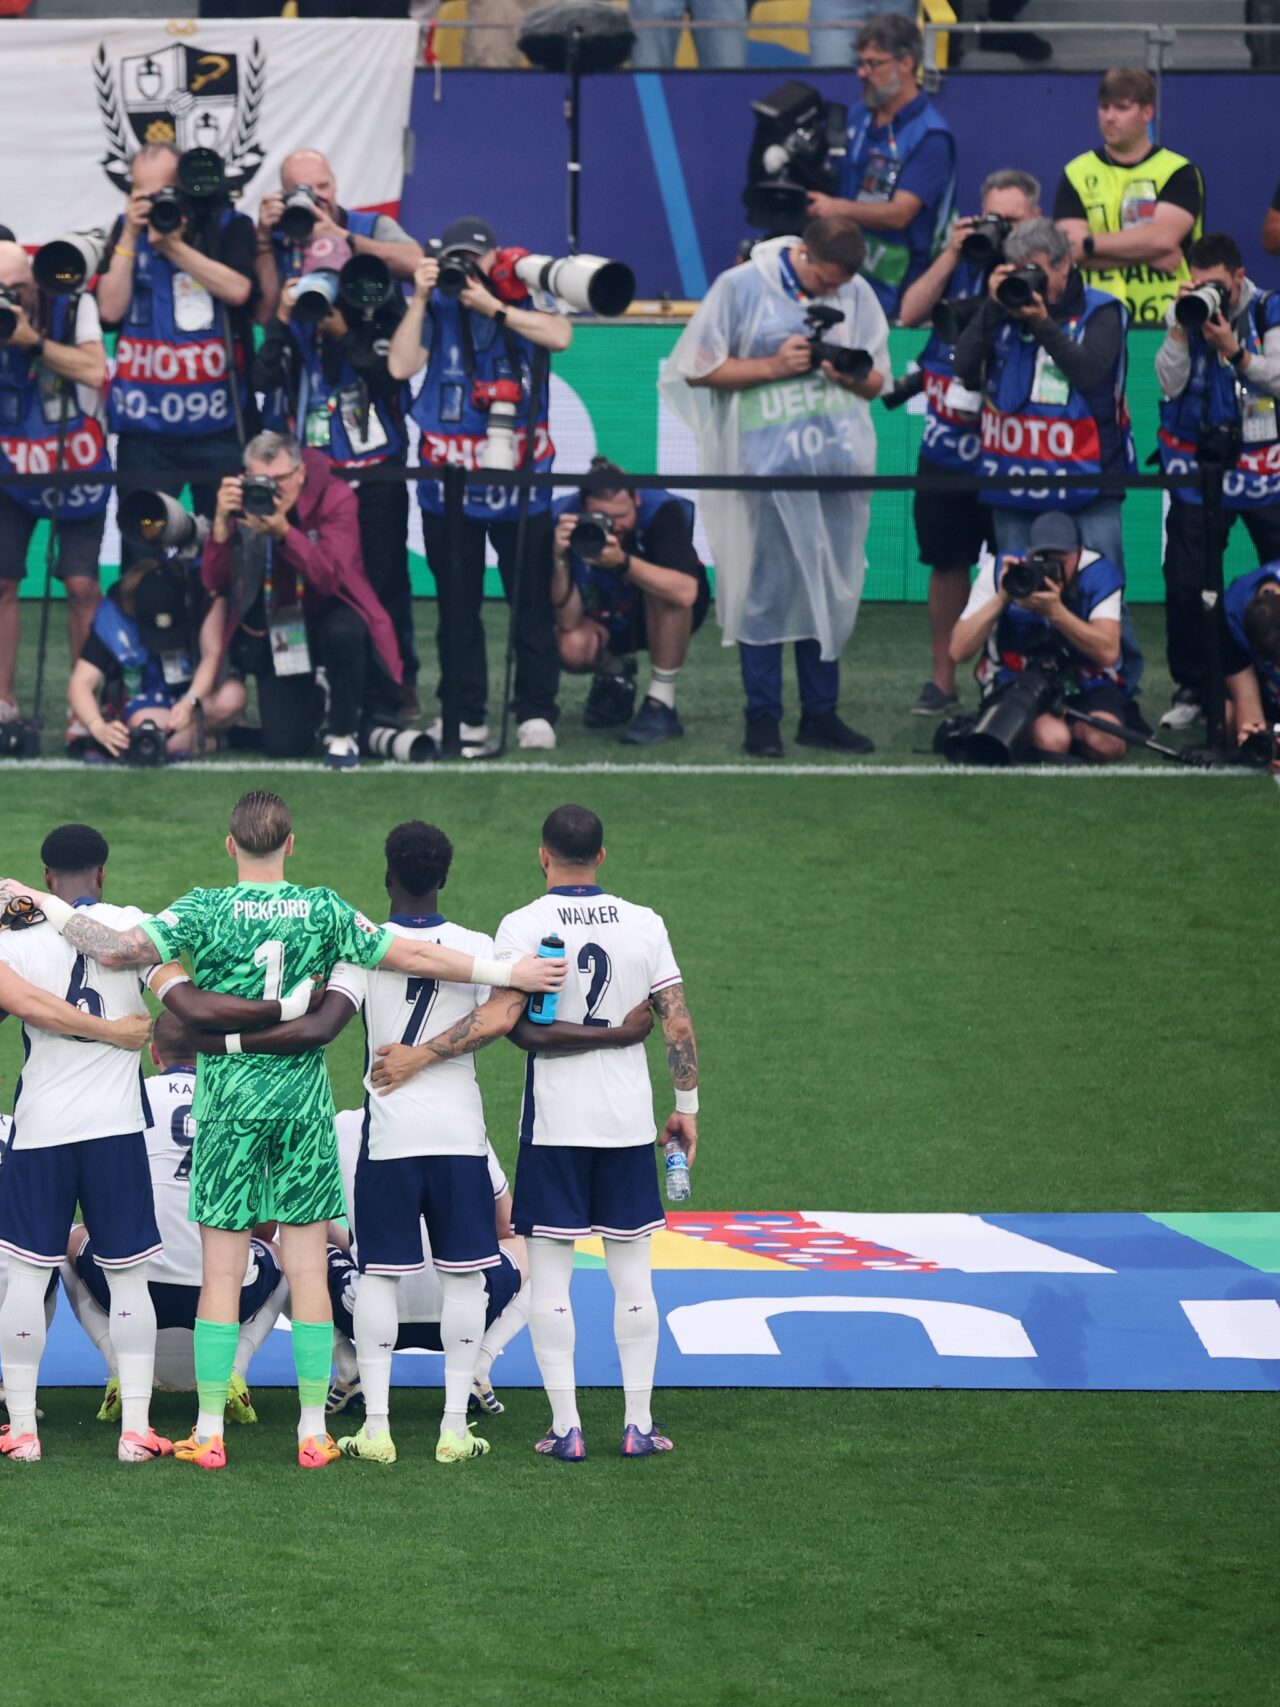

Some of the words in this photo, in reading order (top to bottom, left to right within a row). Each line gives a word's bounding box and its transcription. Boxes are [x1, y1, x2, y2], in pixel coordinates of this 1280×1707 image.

[117, 339, 226, 381] PHOTO
[233, 899, 310, 919] PICKFORD
[557, 905, 619, 926] WALKER
[254, 940, 285, 1001] 1
[577, 942, 612, 1029] 2
[401, 977, 440, 1048] 7
[168, 1082, 193, 1095] KA
